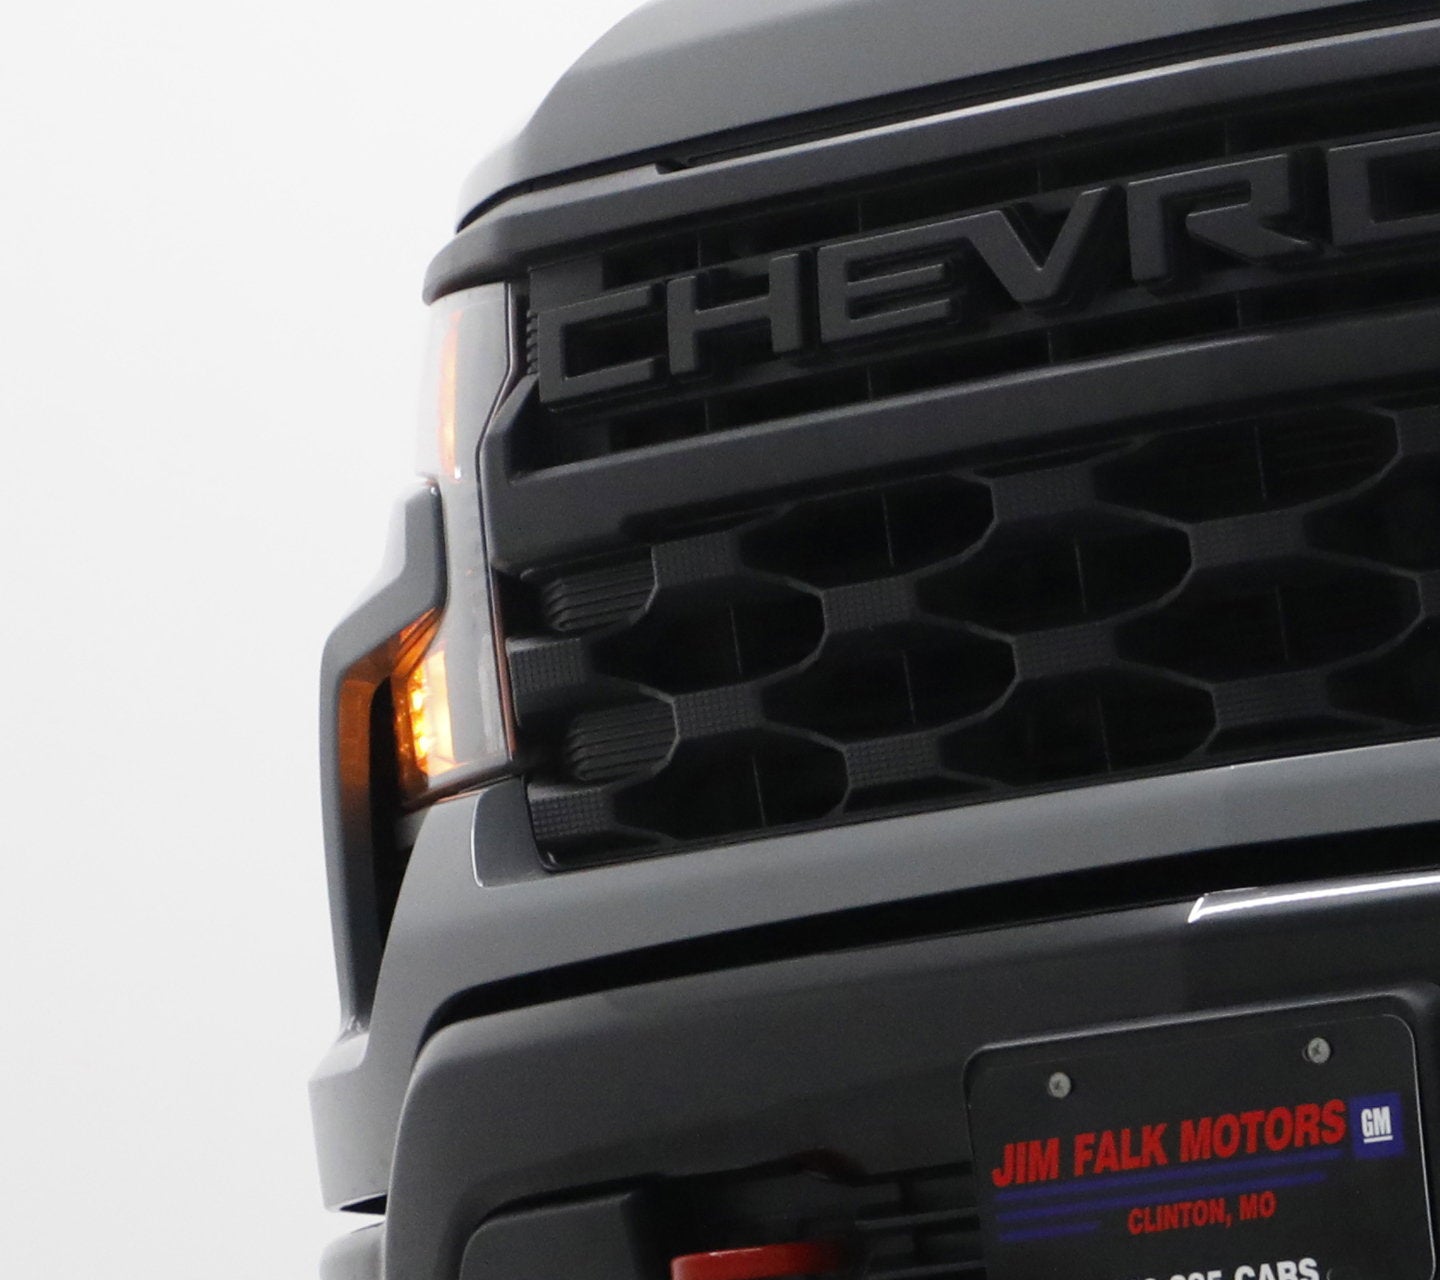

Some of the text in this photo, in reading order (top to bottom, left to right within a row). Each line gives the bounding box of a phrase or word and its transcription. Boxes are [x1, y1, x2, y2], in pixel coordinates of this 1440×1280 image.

[992, 1098, 1347, 1188] JIM FALK MOTORS
[1360, 1105, 1394, 1139] GM
[1127, 1191, 1277, 1235] CLINTON, MO
